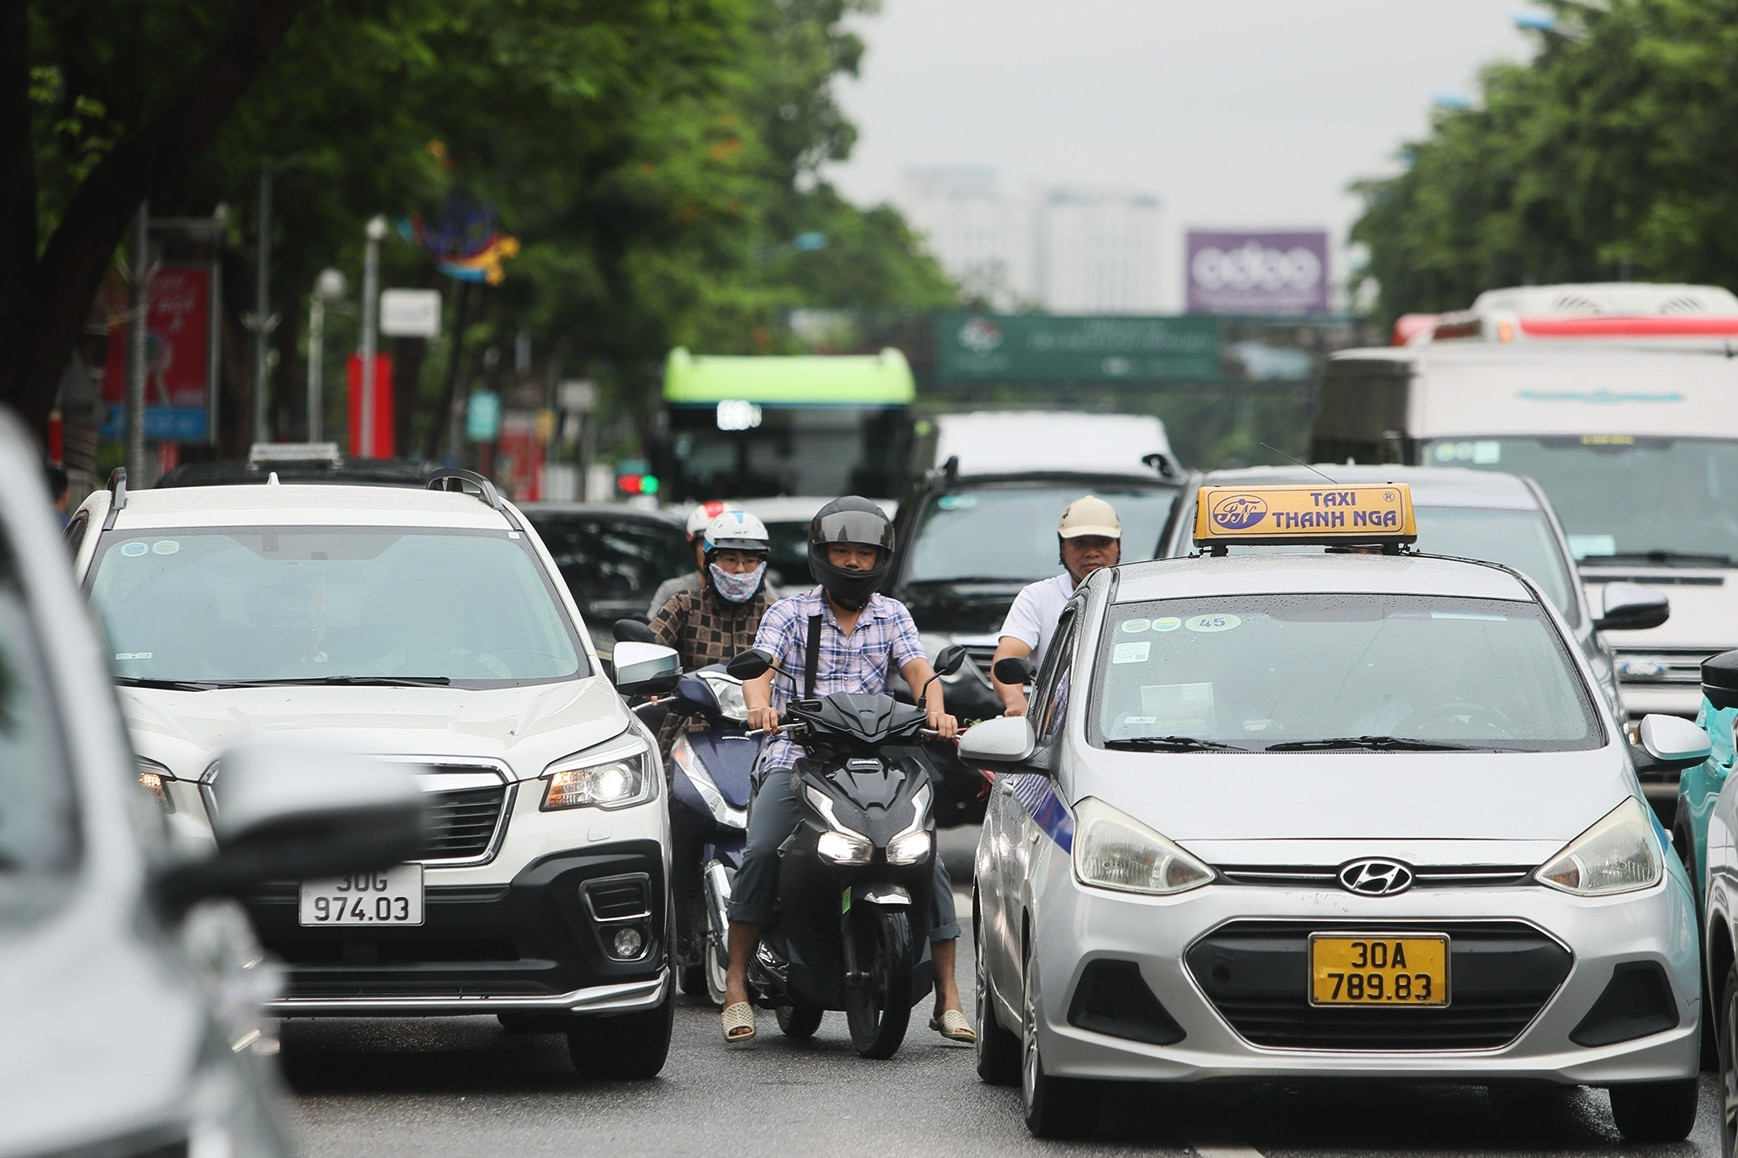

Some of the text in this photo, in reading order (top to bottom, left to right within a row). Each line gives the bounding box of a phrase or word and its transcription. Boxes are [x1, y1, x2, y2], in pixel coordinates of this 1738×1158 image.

[1310, 492, 1356, 507] TAXI
[1272, 510, 1396, 529] THANH NGA
[1199, 617, 1226, 628] 45
[314, 896, 409, 921] 974.03
[1351, 942, 1407, 969] 30A
[1327, 973, 1432, 1000] 789.83
